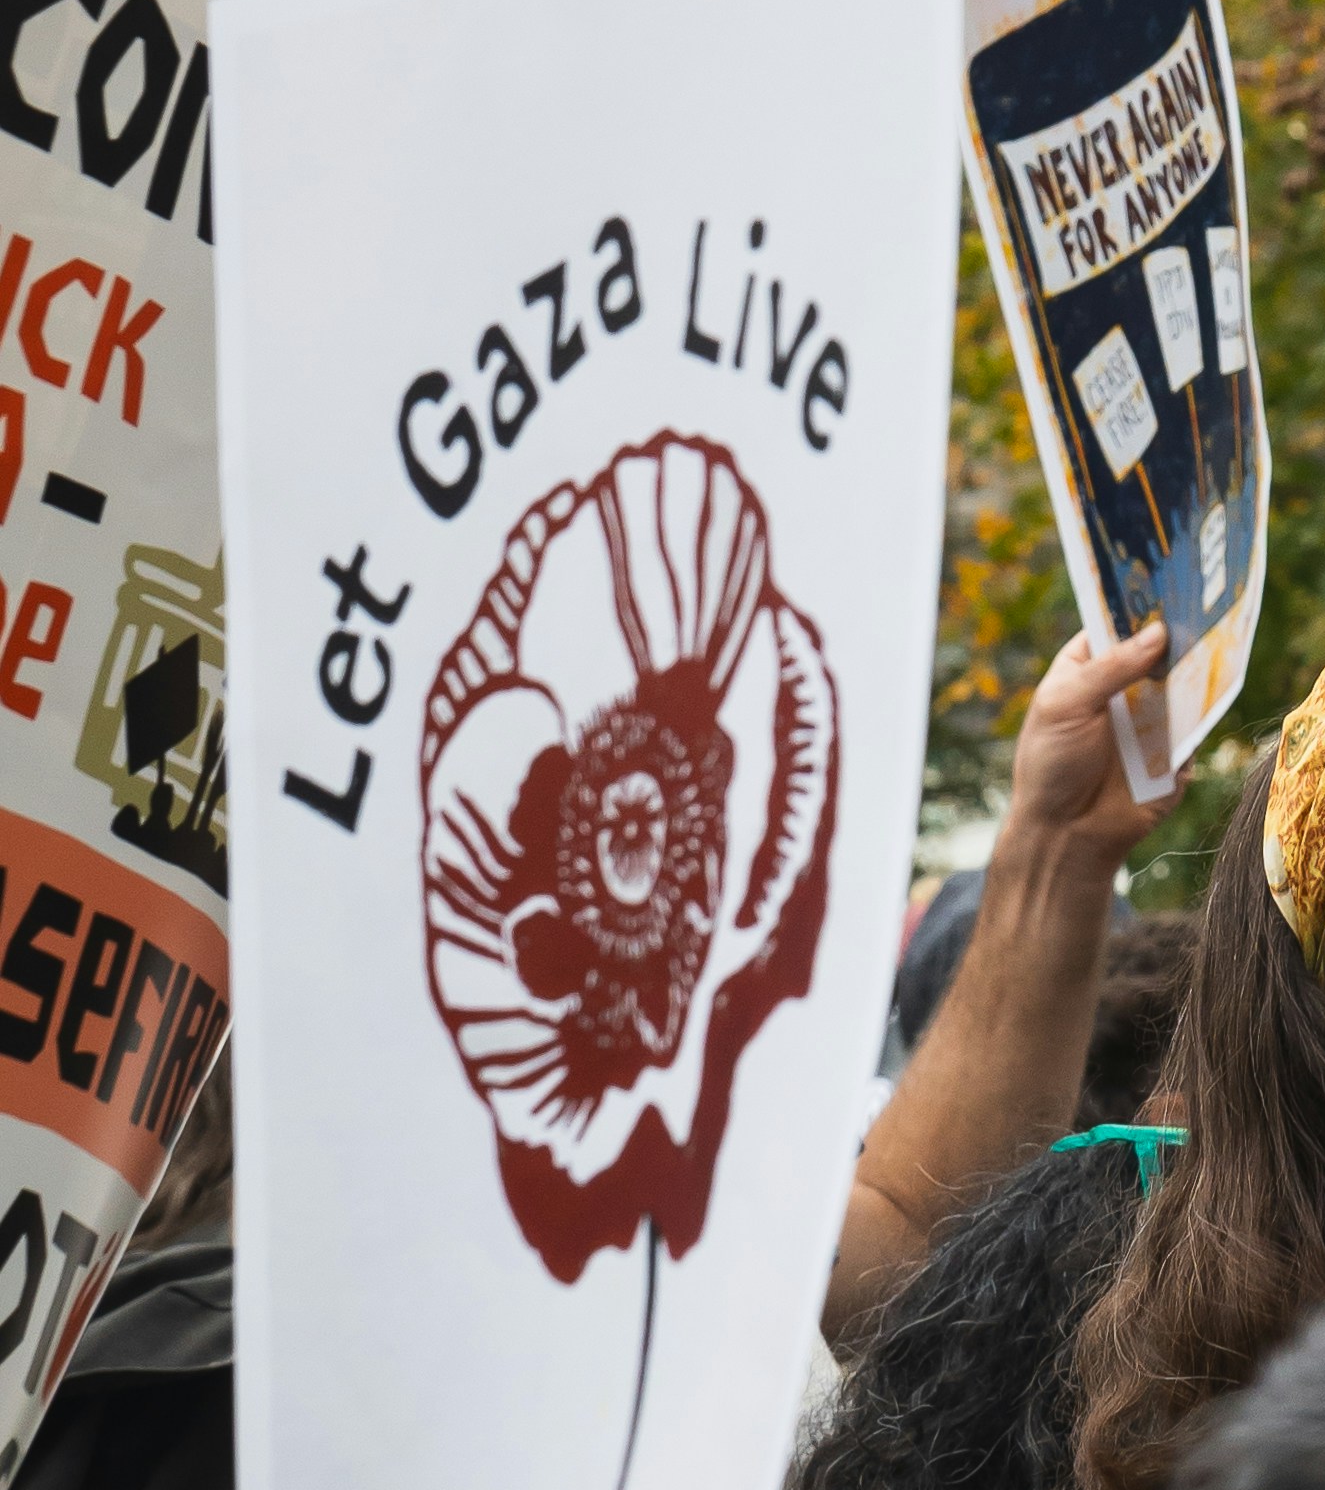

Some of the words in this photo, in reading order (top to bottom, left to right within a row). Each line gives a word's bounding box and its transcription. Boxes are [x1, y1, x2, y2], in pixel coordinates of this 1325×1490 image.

[1025, 119, 1131, 225] NEVER
[1127, 47, 1206, 164] AGAIN
[1058, 208, 1119, 279] FOR
[1124, 125, 1210, 244] ANYONE
[282, 544, 411, 834] Let
[397, 214, 644, 520] Gaza
[682, 219, 849, 452] Live
